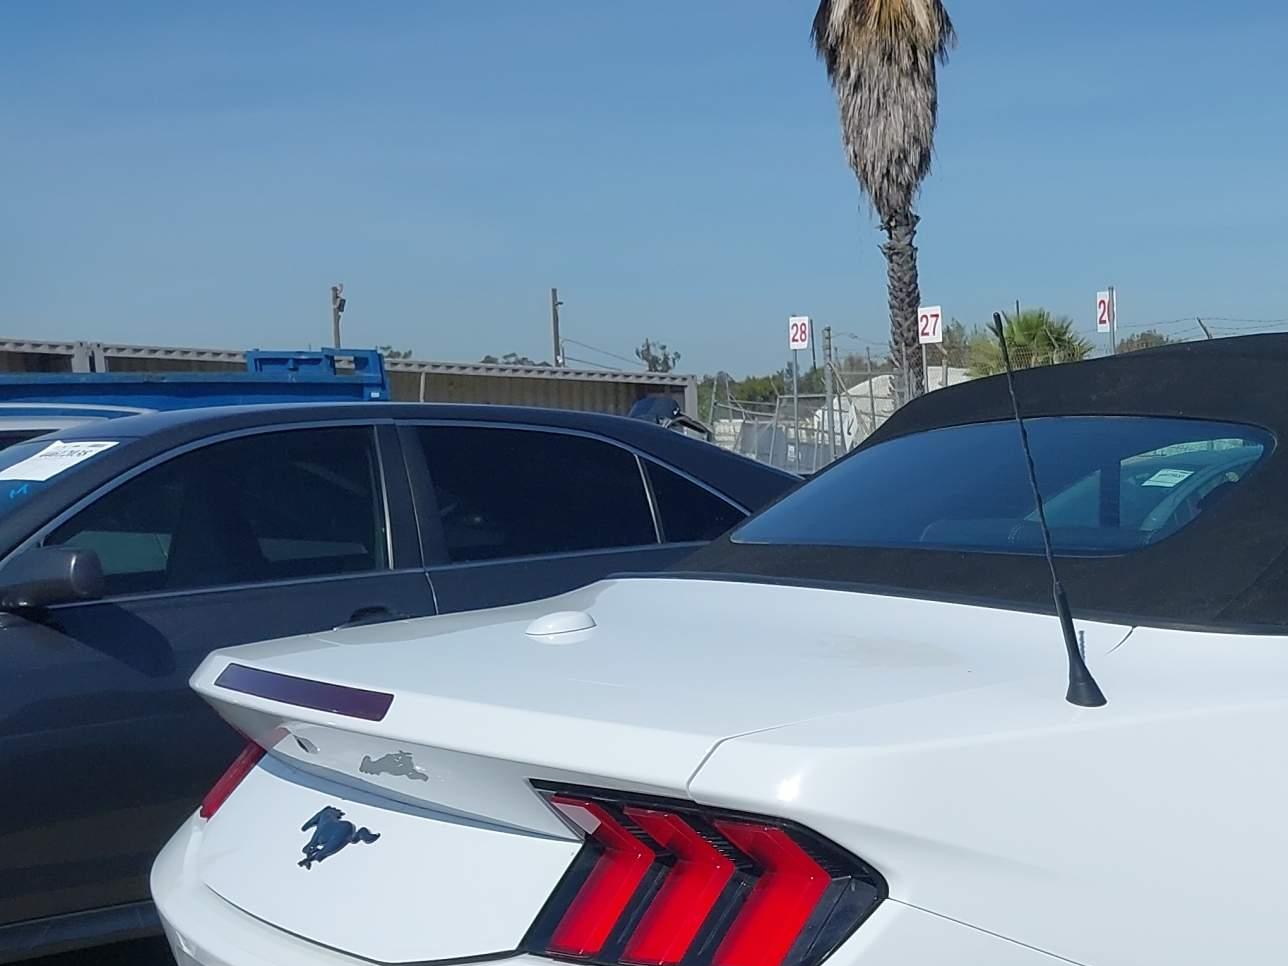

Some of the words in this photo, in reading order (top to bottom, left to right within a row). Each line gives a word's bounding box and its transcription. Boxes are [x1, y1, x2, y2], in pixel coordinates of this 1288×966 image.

[1098, 299, 1115, 324] 2
[791, 322, 807, 342] 28
[920, 314, 940, 337] 27
